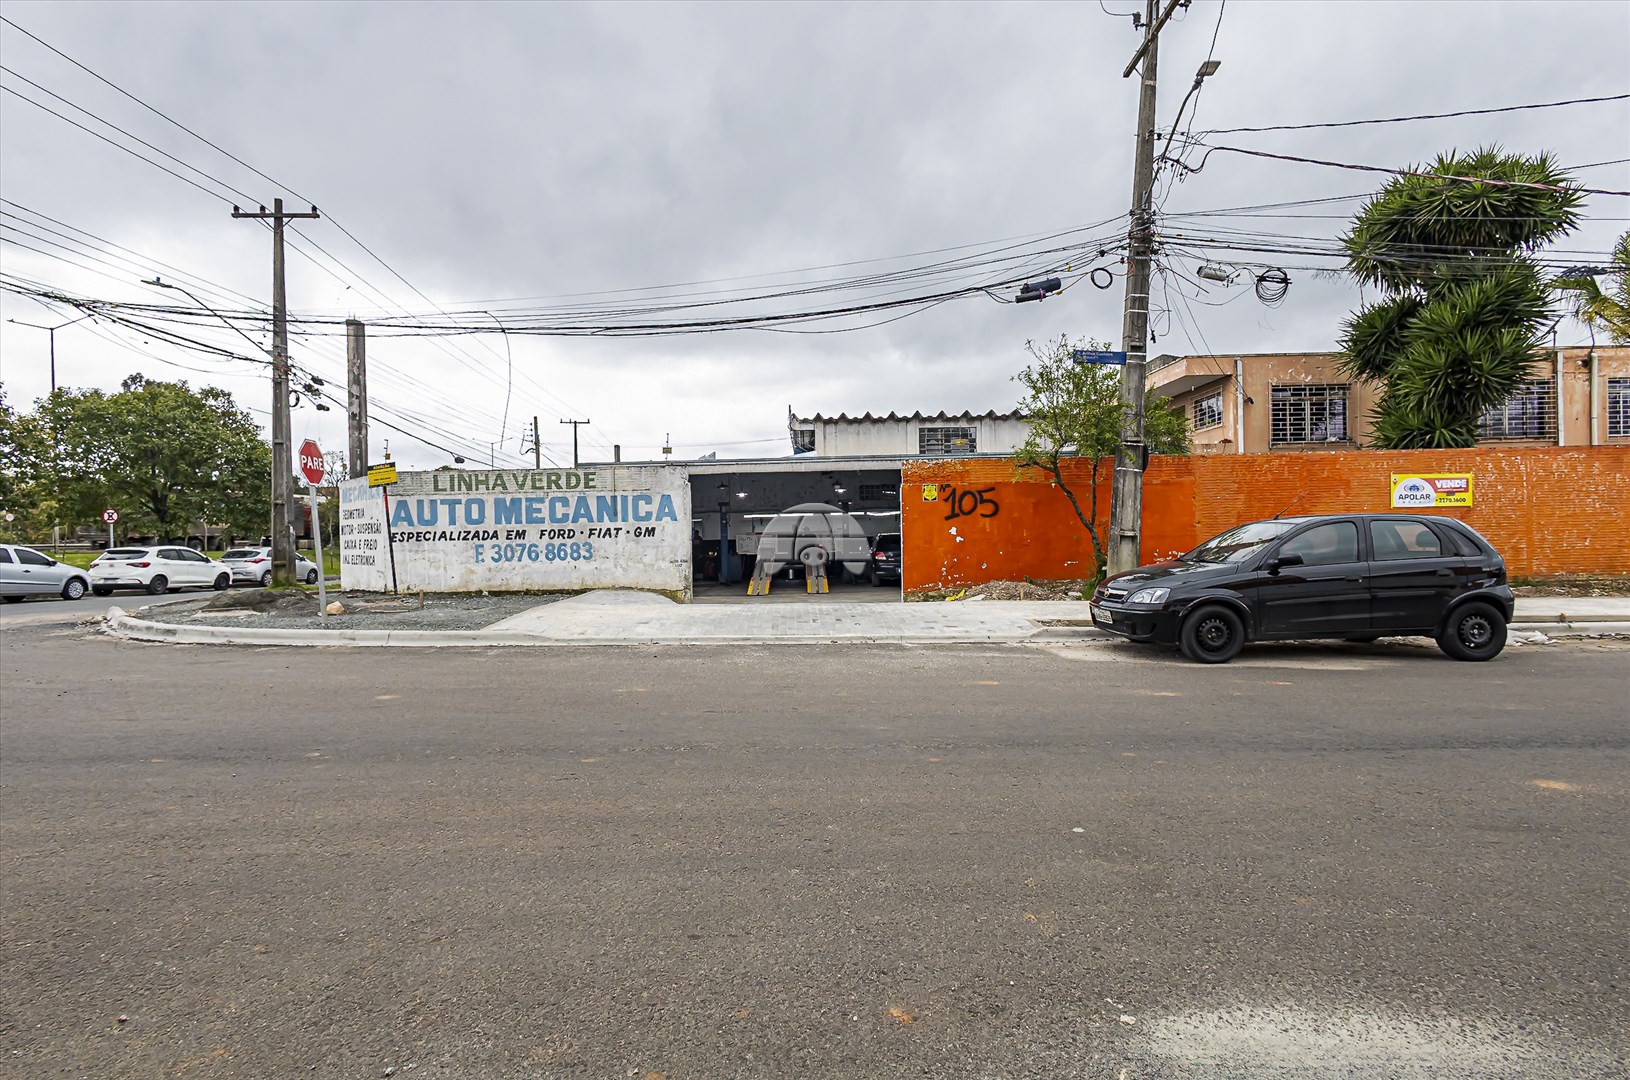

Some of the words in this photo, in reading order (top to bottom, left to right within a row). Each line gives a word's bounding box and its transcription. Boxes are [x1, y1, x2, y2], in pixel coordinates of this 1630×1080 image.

[301, 455, 324, 471] PARE
[433, 473, 509, 492] LINHA
[512, 471, 597, 490] VERDE
[1435, 479, 1467, 489] VENDE
[943, 486, 999, 522] 105
[1398, 493, 1431, 501] APOLAR
[391, 498, 486, 528] AUTO
[391, 530, 499, 543] ESPECIALIZADA
[505, 529, 527, 541] EM
[539, 528, 576, 540] FORD
[587, 527, 623, 540] FIAT
[633, 526, 656, 538] GM
[344, 539, 357, 551] CAIXA
[358, 539, 362, 550] E
